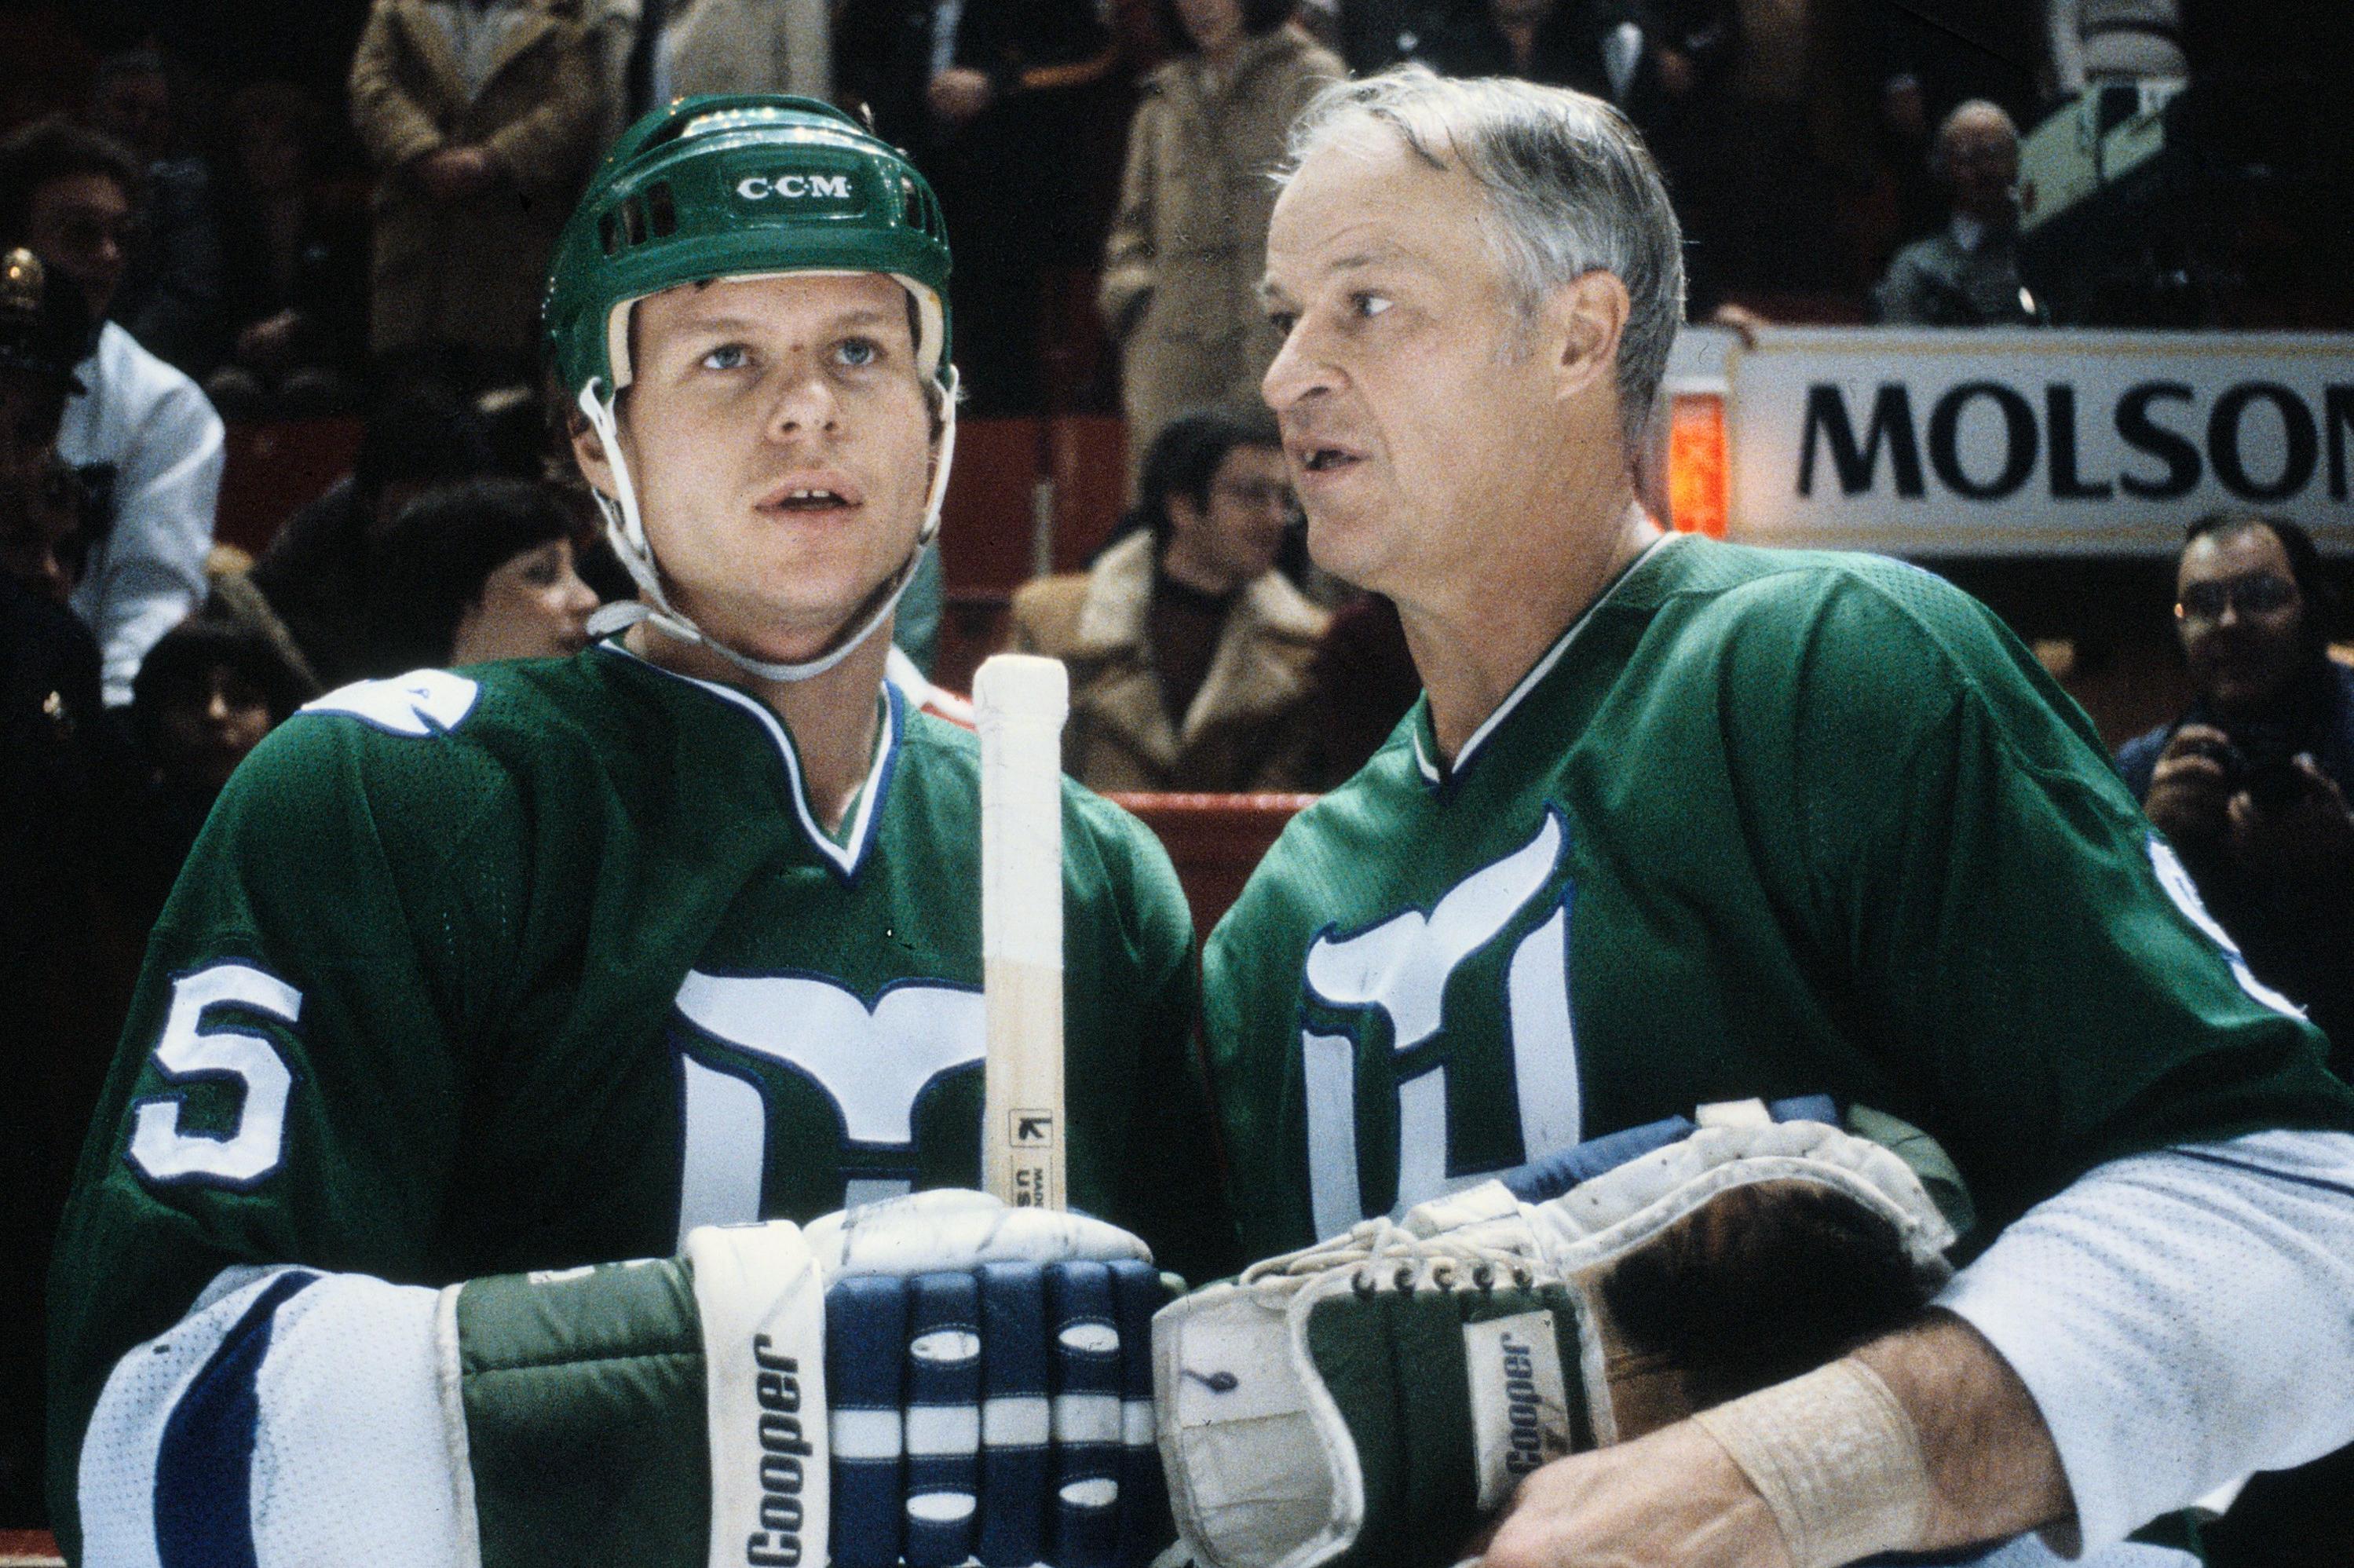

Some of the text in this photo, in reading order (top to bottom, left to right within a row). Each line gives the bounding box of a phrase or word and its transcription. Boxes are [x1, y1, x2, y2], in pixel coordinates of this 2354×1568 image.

[1797, 380, 2354, 503] MOLSO
[126, 959, 305, 1186] 5
[747, 1332, 813, 1568] Cooper
[1500, 1332, 1544, 1474] Cooper
